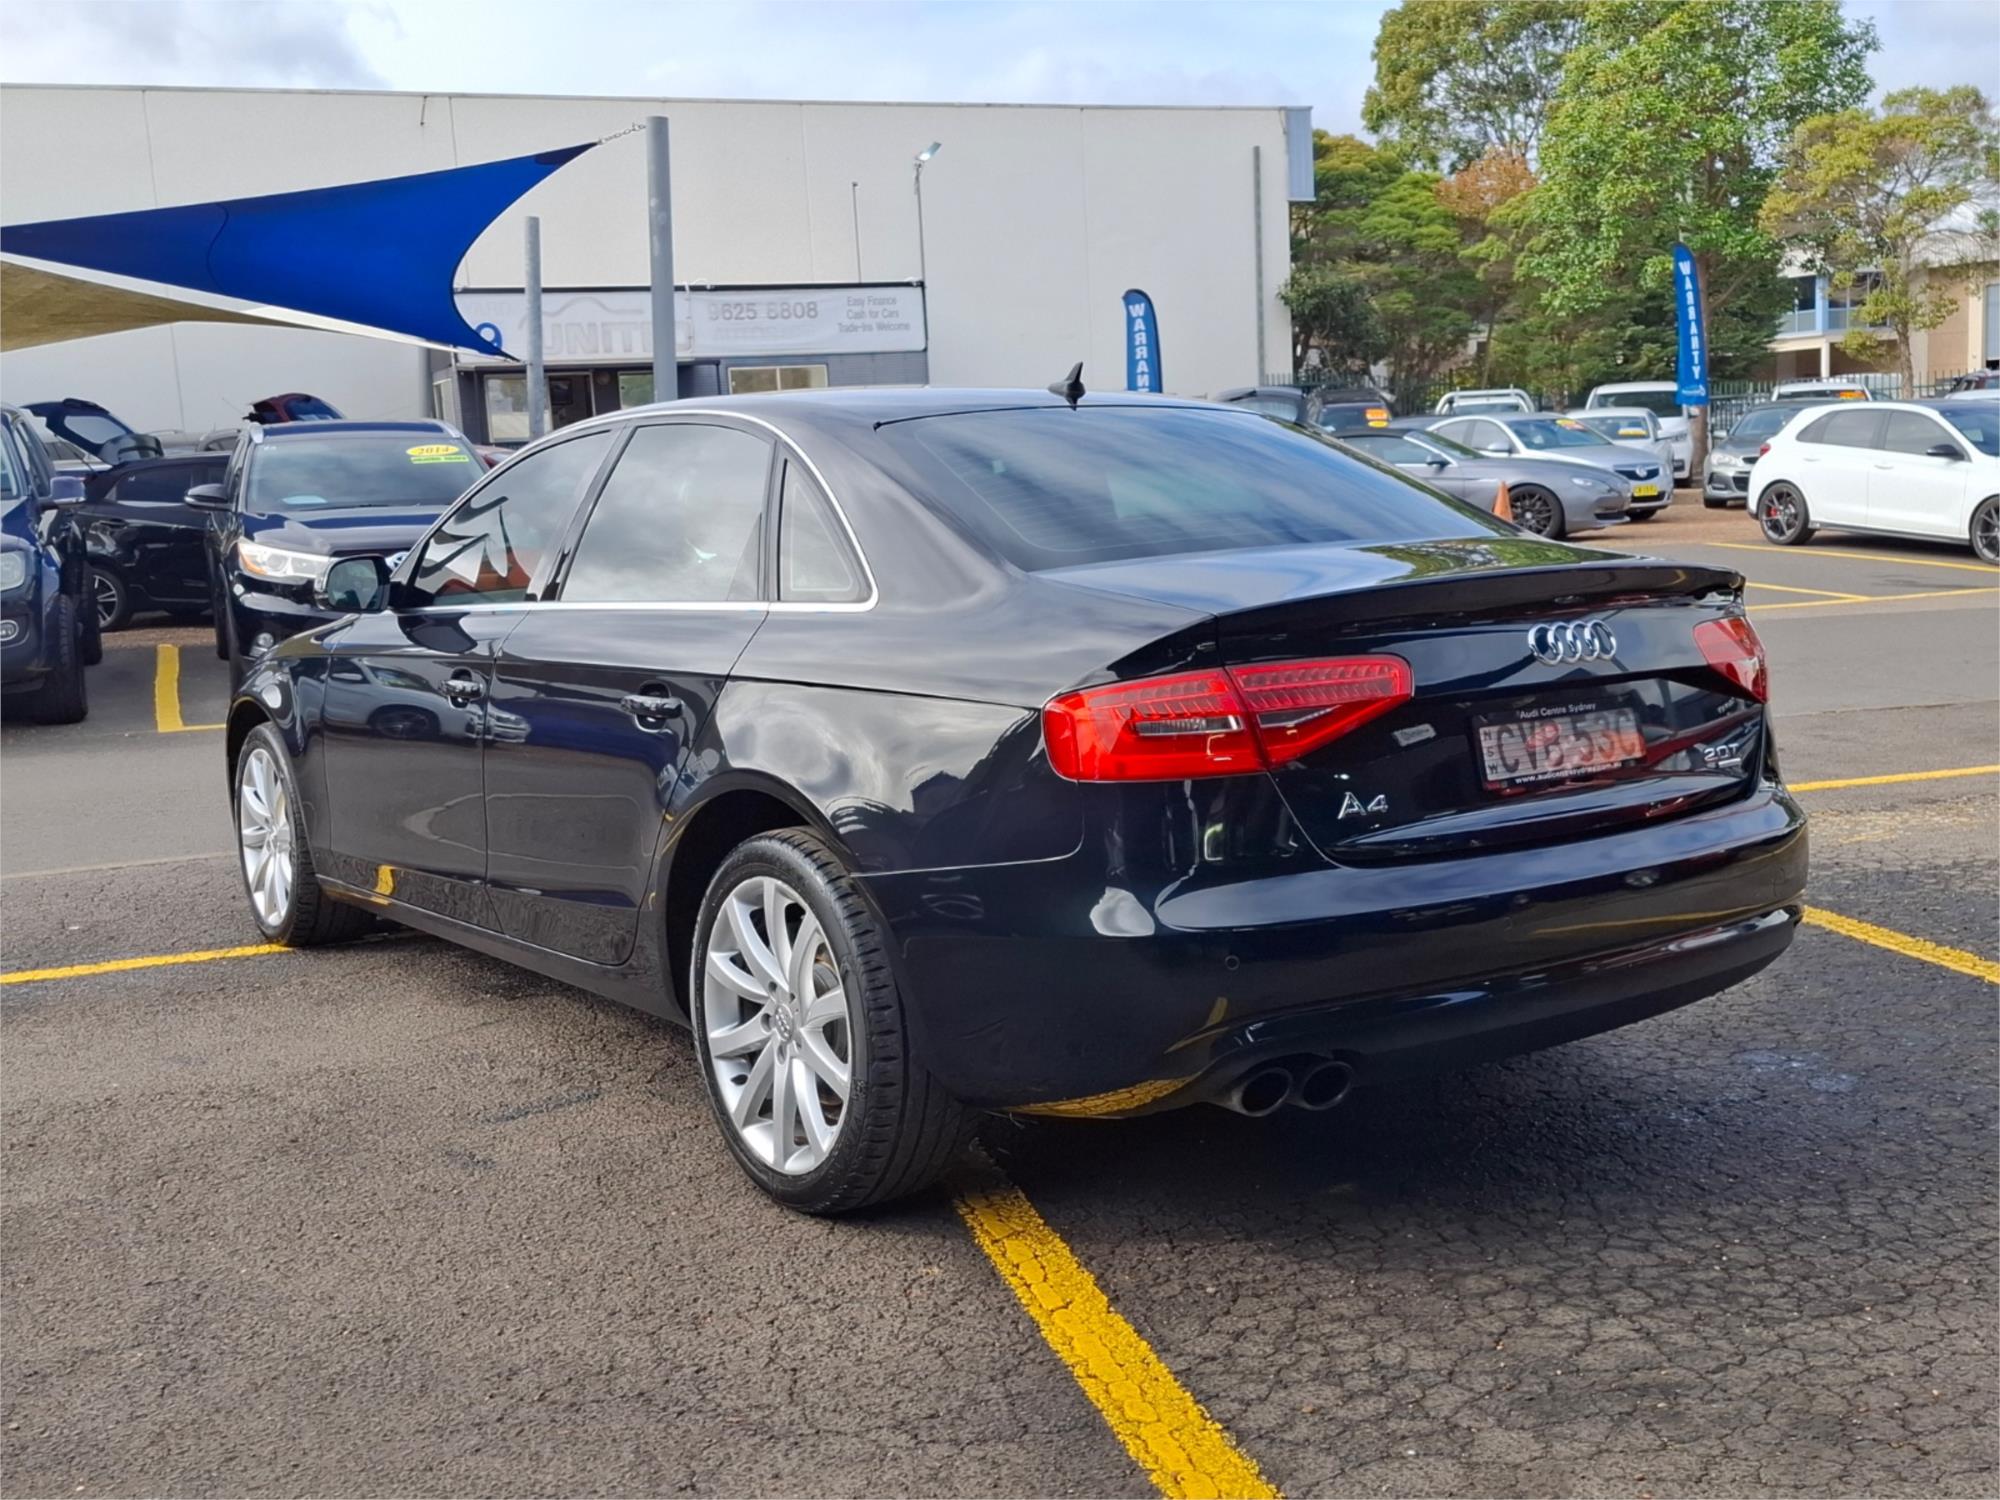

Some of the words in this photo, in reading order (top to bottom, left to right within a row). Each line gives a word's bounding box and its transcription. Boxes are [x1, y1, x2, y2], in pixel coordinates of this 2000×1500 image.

[708, 302, 757, 321] 9625
[846, 308, 865, 319] Cash
[847, 296, 865, 308] Easy
[1678, 260, 1701, 380] WARRANTY
[541, 320, 694, 354] UNITD
[1128, 302, 1150, 392] WARRAN
[1519, 708, 1539, 719] Audi
[1540, 706, 1567, 717] Centre
[1568, 702, 1597, 714] Sydney
[1337, 791, 1389, 820] A4
